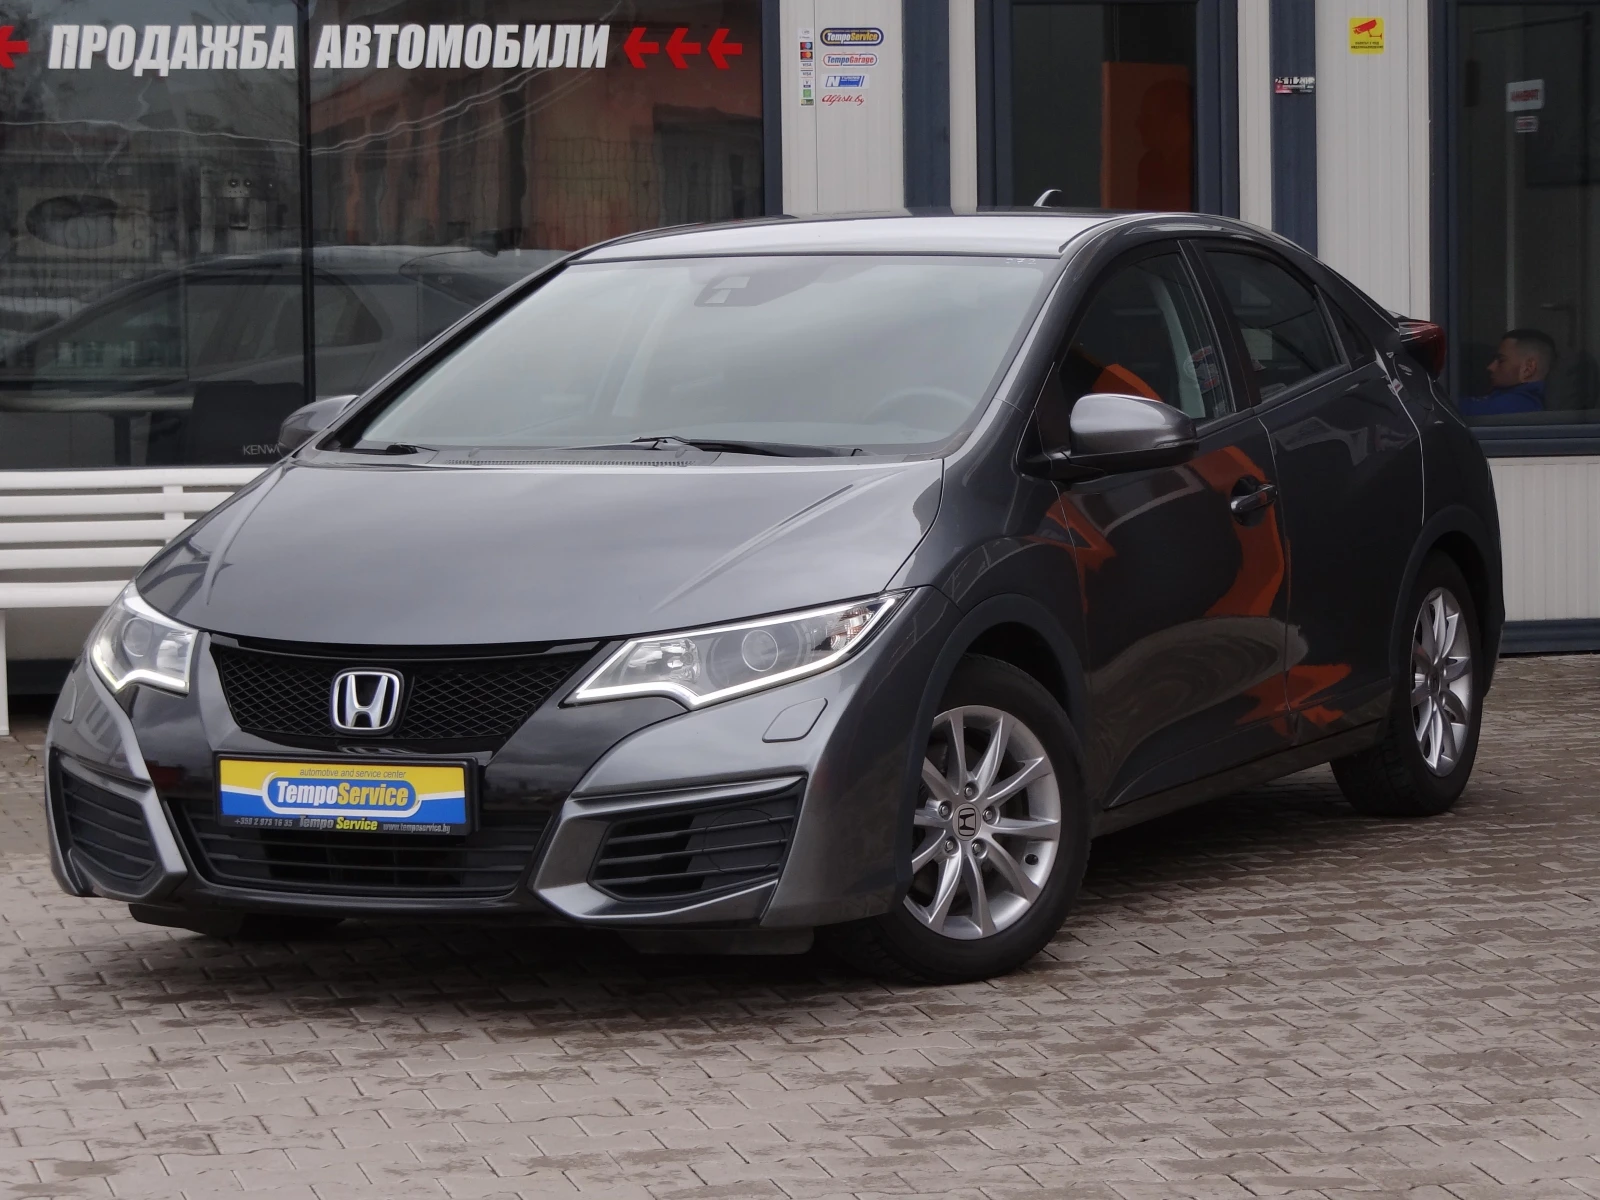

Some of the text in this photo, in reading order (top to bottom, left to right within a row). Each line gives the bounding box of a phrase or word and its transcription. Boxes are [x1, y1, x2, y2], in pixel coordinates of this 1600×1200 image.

[827, 32, 878, 44] TempoService
[47, 24, 611, 77] ПРОДАЖБА АВТОМОБИЛИ
[827, 55, 874, 66] TempoGarage
[243, 444, 280, 455] KENW
[299, 768, 407, 778] automotive and service center
[277, 781, 409, 806] TempoService
[254, 818, 259, 826] 2
[300, 816, 334, 829] Tempo
[336, 817, 378, 830] Service
